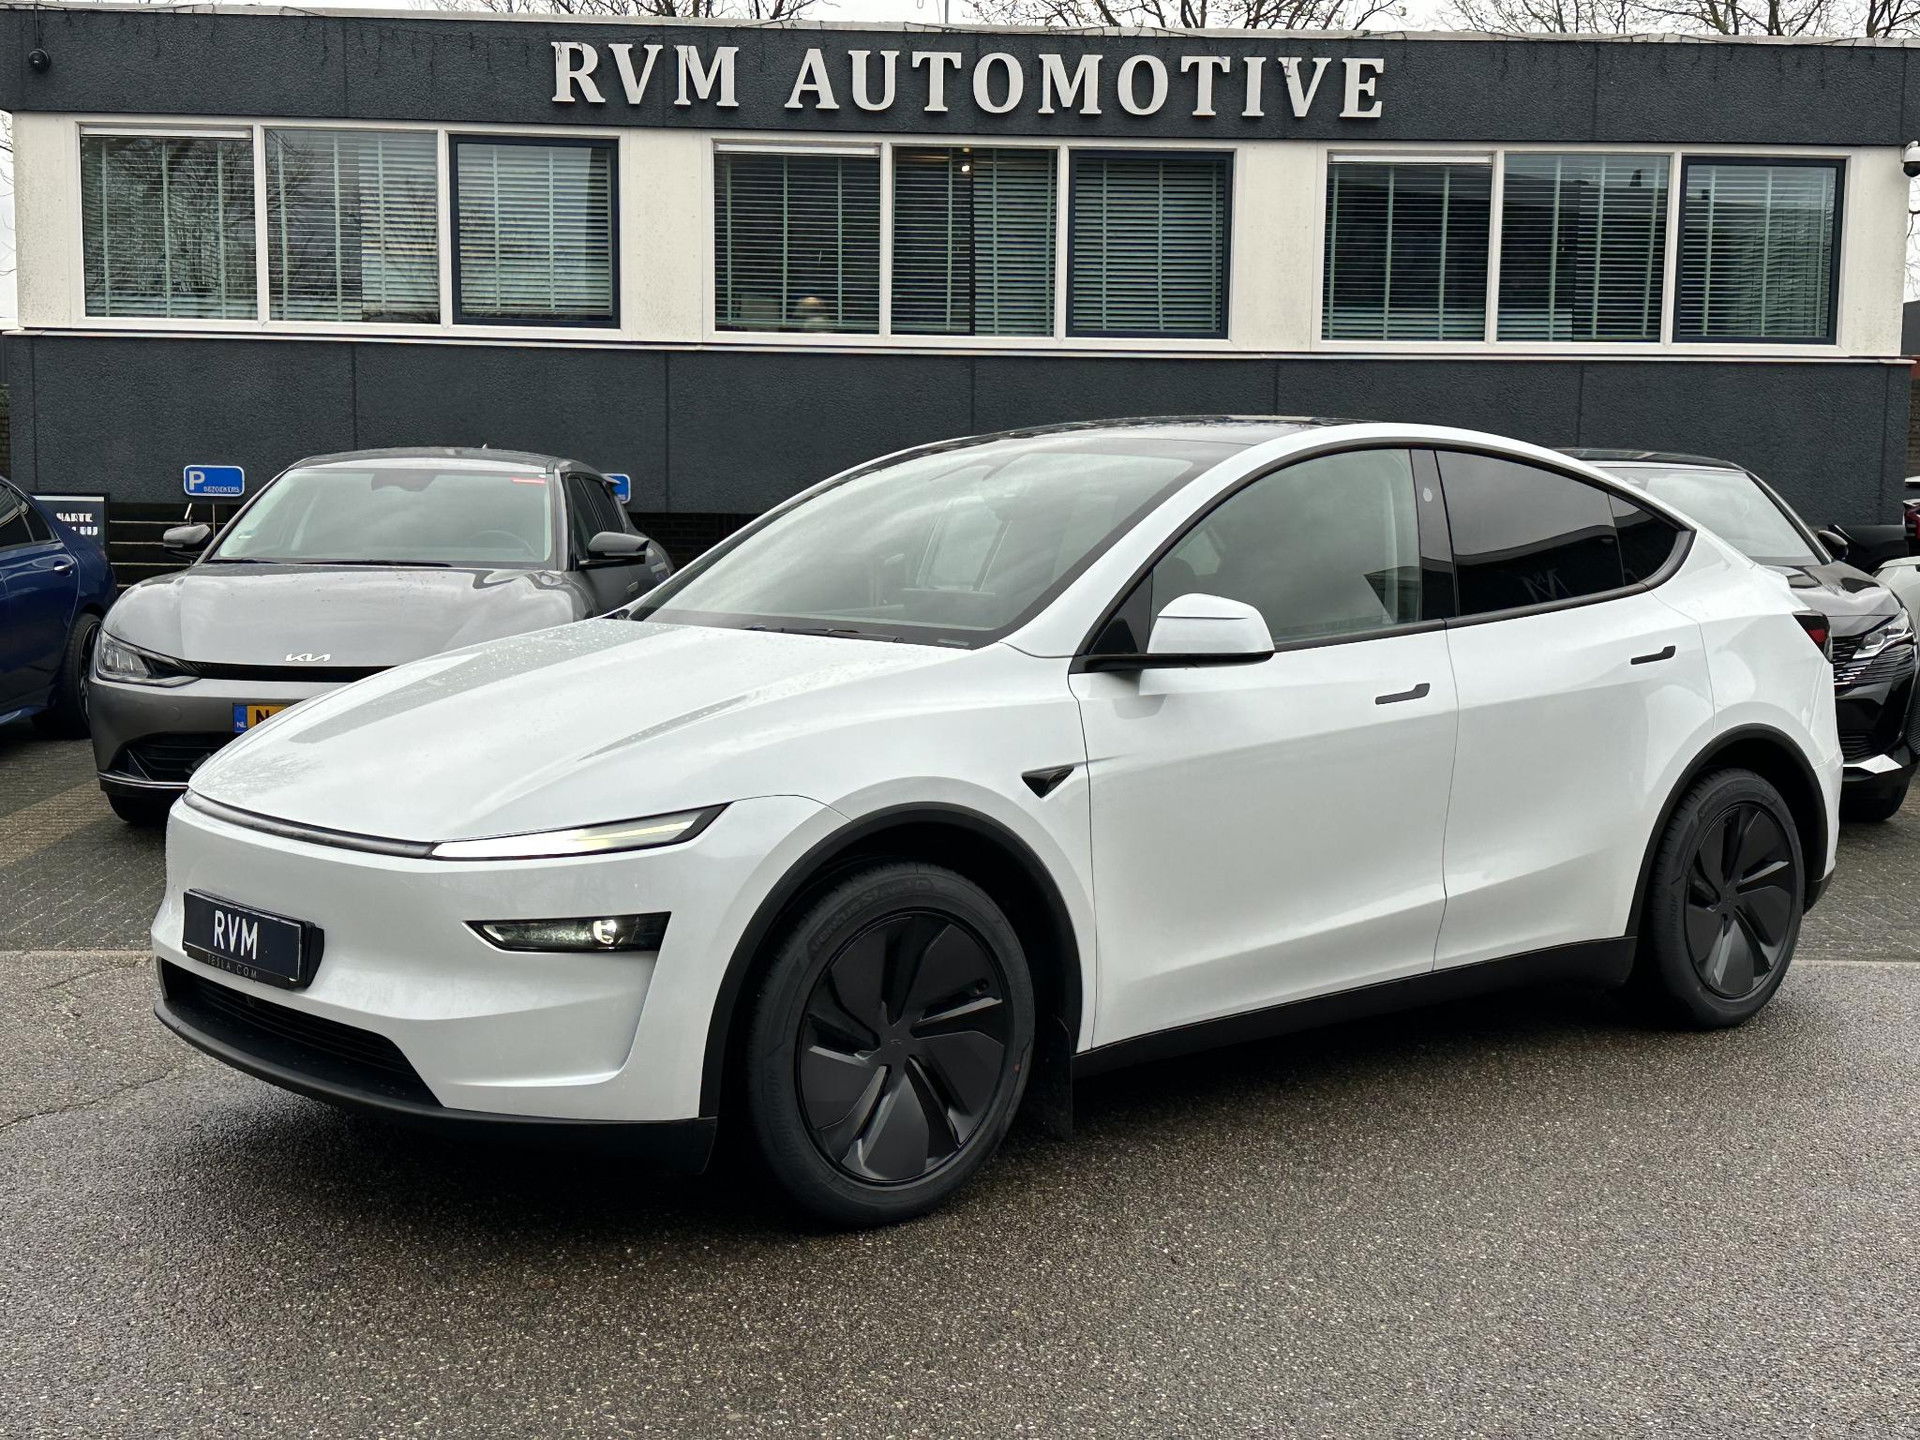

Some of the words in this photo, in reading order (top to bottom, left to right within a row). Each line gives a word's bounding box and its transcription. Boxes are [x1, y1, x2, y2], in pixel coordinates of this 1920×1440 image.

[551, 42, 739, 107] RVM
[784, 49, 1385, 118] AUTOMOTIVE
[189, 470, 206, 491] P
[213, 910, 259, 960] RVM
